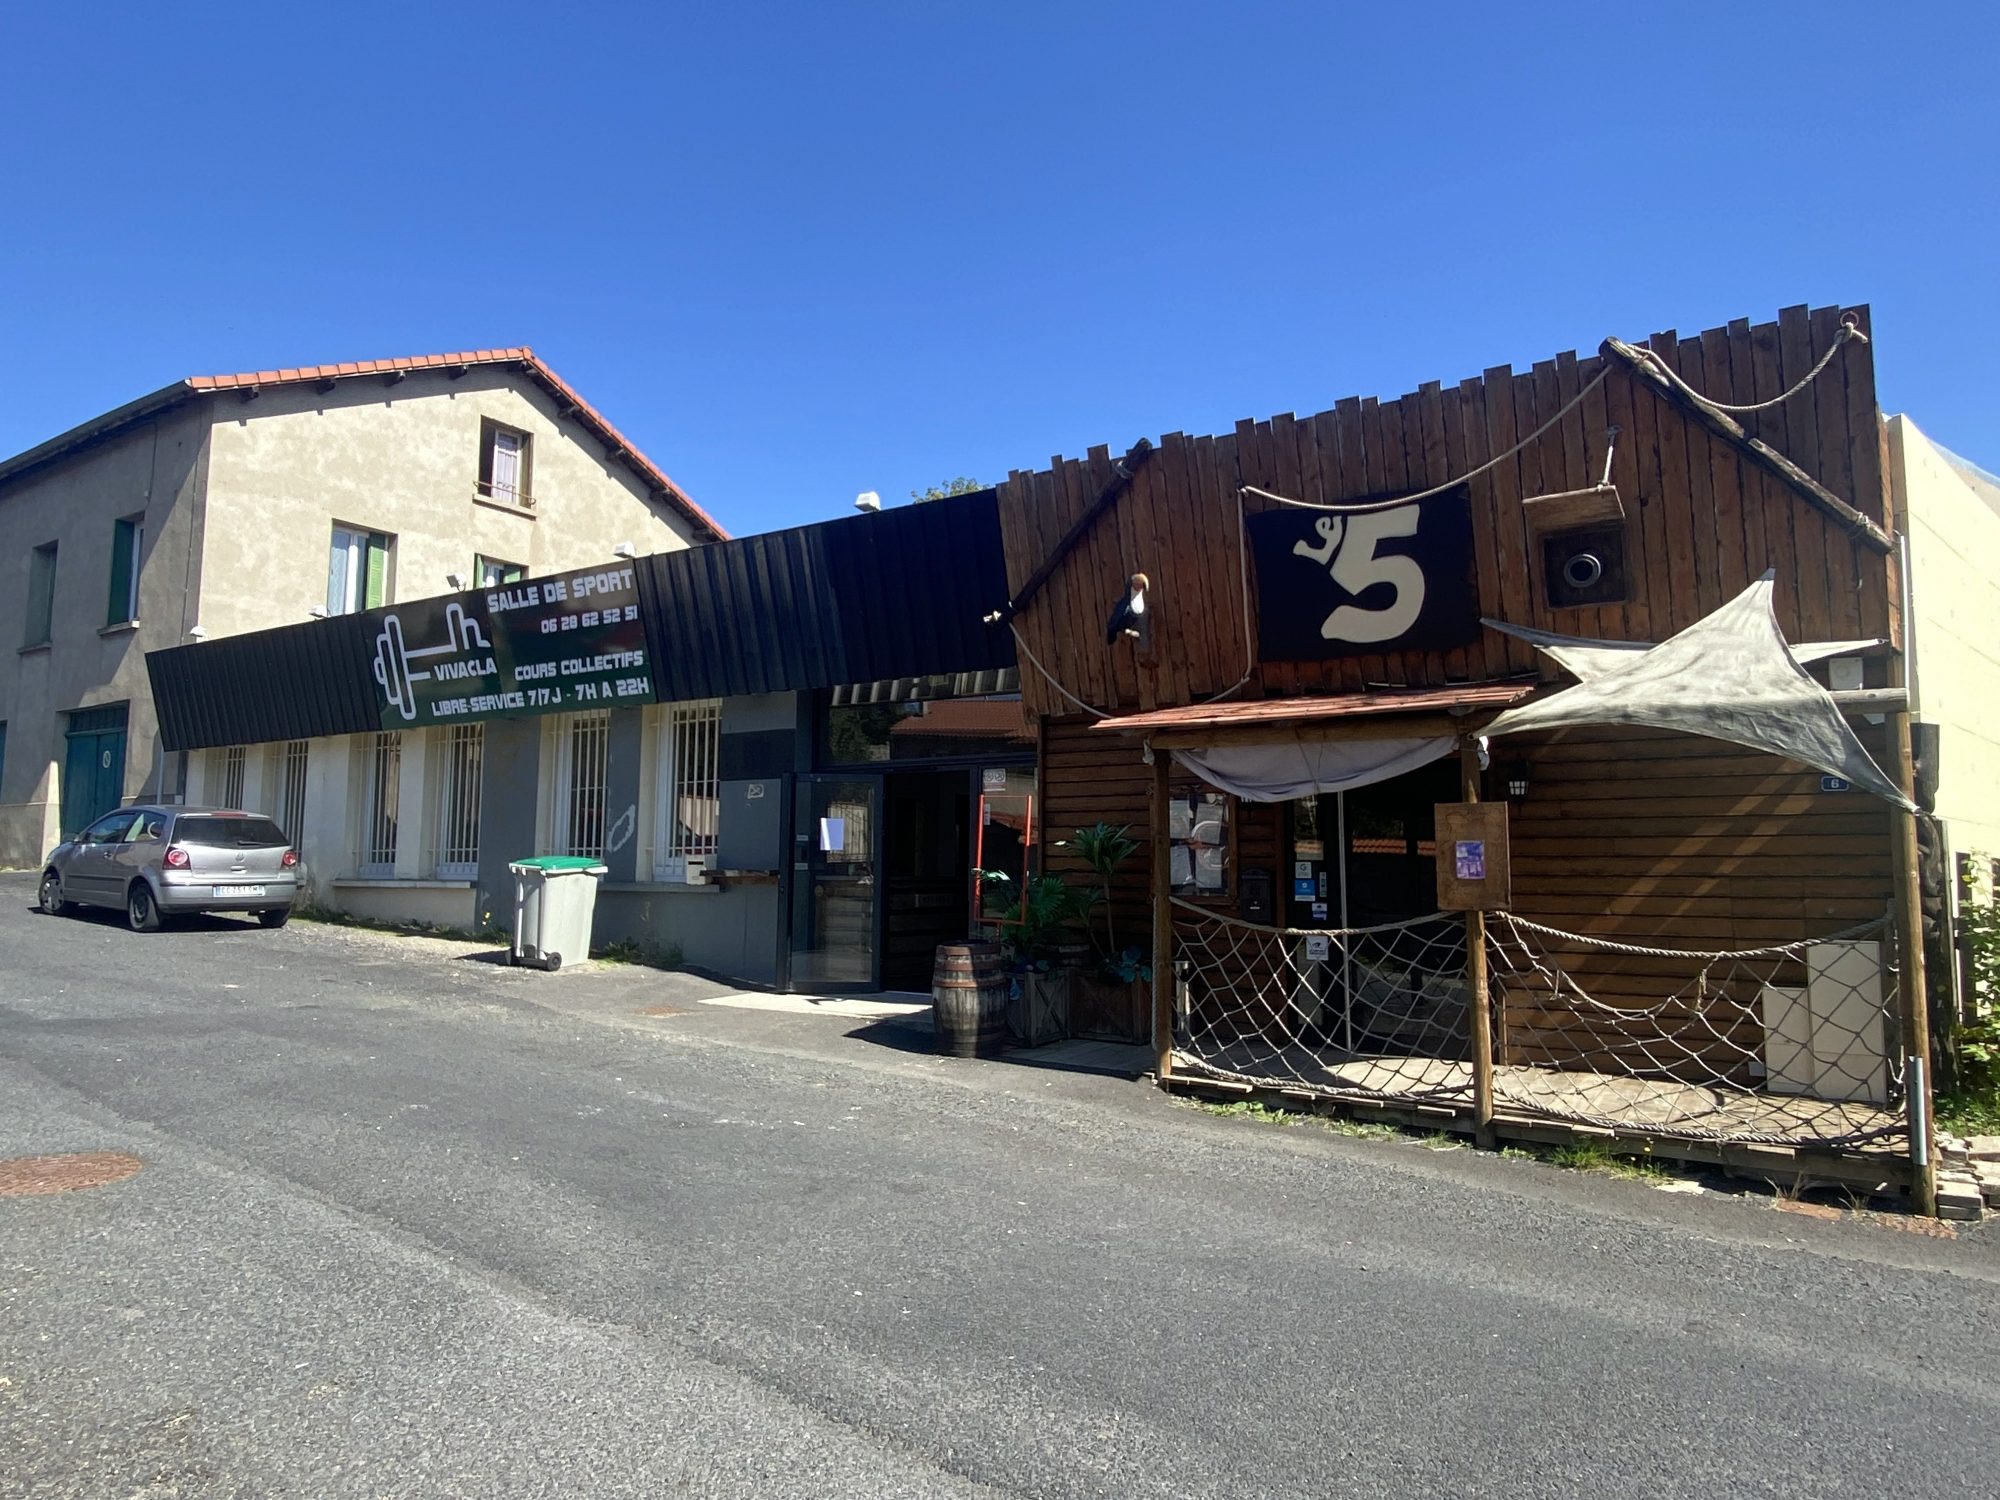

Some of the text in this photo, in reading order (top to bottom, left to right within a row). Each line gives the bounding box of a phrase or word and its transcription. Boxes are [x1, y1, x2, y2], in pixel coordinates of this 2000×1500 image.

[1321, 504, 1426, 643] 5
[487, 568, 633, 614] SALLE DE SPORT
[541, 605, 638, 634] 06 28 62 52 51
[434, 657, 498, 681] VIVACLA
[514, 650, 644, 681] COURS COLLECTIFS
[431, 691, 525, 717] LIBRE-SERVICE
[575, 682, 598, 701] 7H
[602, 681, 613, 698] A
[615, 676, 650, 697] 22H
[1831, 779, 1840, 789] 6
